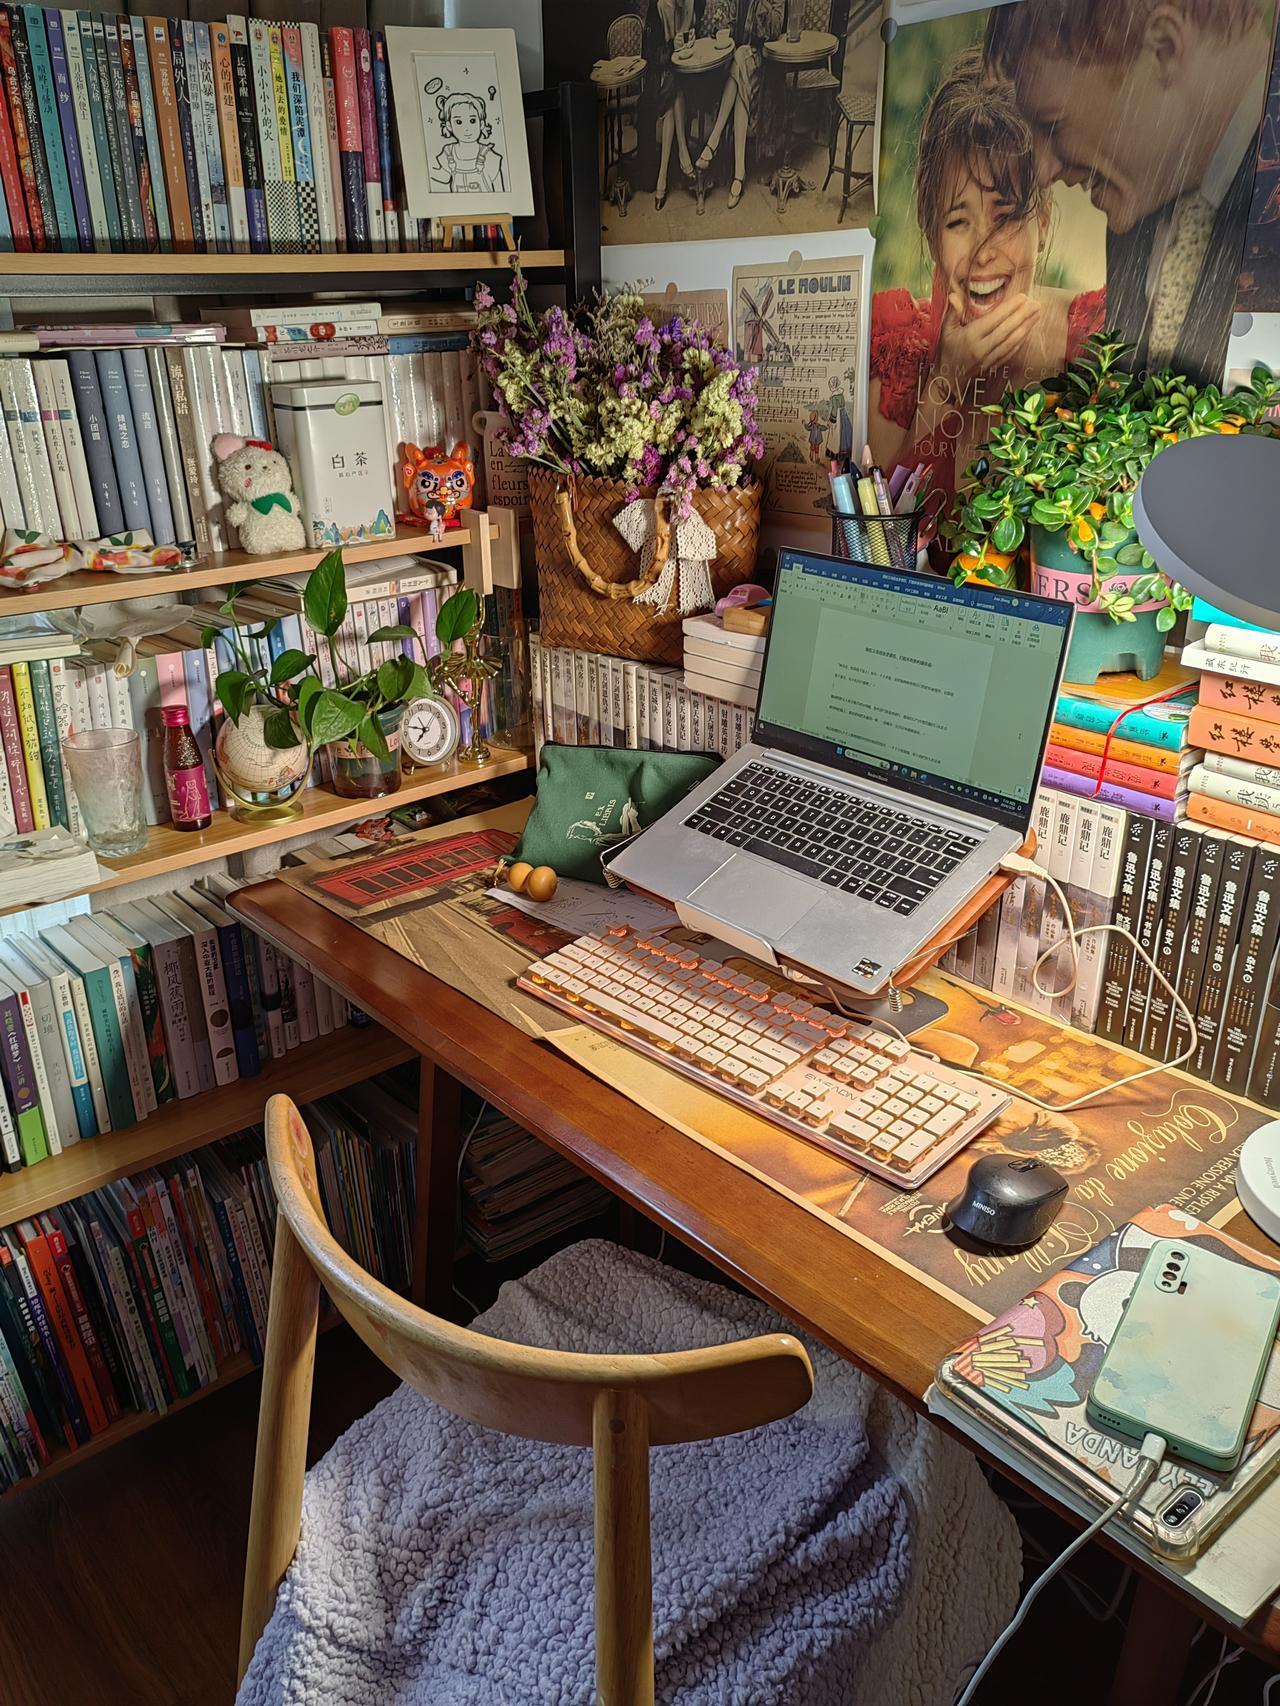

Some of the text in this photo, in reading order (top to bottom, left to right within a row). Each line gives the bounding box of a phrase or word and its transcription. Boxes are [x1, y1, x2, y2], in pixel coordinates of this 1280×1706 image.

[57, 73, 70, 103] 面纱
[173, 51, 190, 103] 局外人
[200, 58, 213, 96] 冰风暴
[220, 57, 234, 106] 心的重建
[236, 56, 248, 97] 长眠不醒
[258, 65, 274, 141] 小小小小的火
[291, 71, 305, 138] 我们深陷泥潭
[778, 275, 851, 294] LE MOULIN
[918, 362, 1009, 379] FROM THE
[170, 365, 188, 415] 流言私语
[918, 376, 986, 408] LOVE
[89, 414, 101, 441] 小团圆
[117, 414, 130, 448] 倾城之恋
[332, 452, 368, 470] 白茶
[490, 441, 504, 457] La
[913, 440, 948, 458] FOUR
[490, 461, 504, 471] en
[492, 474, 529, 491] fleurs
[1206, 658, 1251, 675] 藏东纪行
[599, 799, 616, 826] LIBRIS
[1038, 806, 1050, 840] 鹿鼎记
[1058, 813, 1070, 847] 鹿鼎记
[1080, 819, 1092, 853] 鹿鼎记
[1100, 826, 1112, 860] 鹿鼎记
[1122, 852, 1138, 895] 鲁迅文集
[1147, 858, 1162, 902] 鲁迅文集
[1169, 866, 1186, 910] 鲁迅文集
[1195, 873, 1212, 918] 鲁迅文集
[1218, 880, 1238, 926] 鲁迅文集
[1250, 890, 1271, 937] 鲁迅文集
[1143, 922, 1152, 938] 书信
[1164, 929, 1174, 946] 杂文
[1190, 938, 1200, 955] 小说
[1214, 945, 1224, 963] 书信
[1244, 955, 1256, 974] 杂文
[164, 961, 186, 1014] 椰风蕉雨
[38, 1004, 54, 1034] 一切境
[1073, 1088, 1240, 1207] Colazione da
[1190, 1156, 1236, 1189] VERSIONE
[1215, 1182, 1226, 1191] A
[972, 1200, 996, 1216] MINISO
[1169, 1187, 1196, 1207] CINE
[1184, 1189, 1221, 1215] RISPLEN
[1066, 1421, 1139, 1470] ANDA
